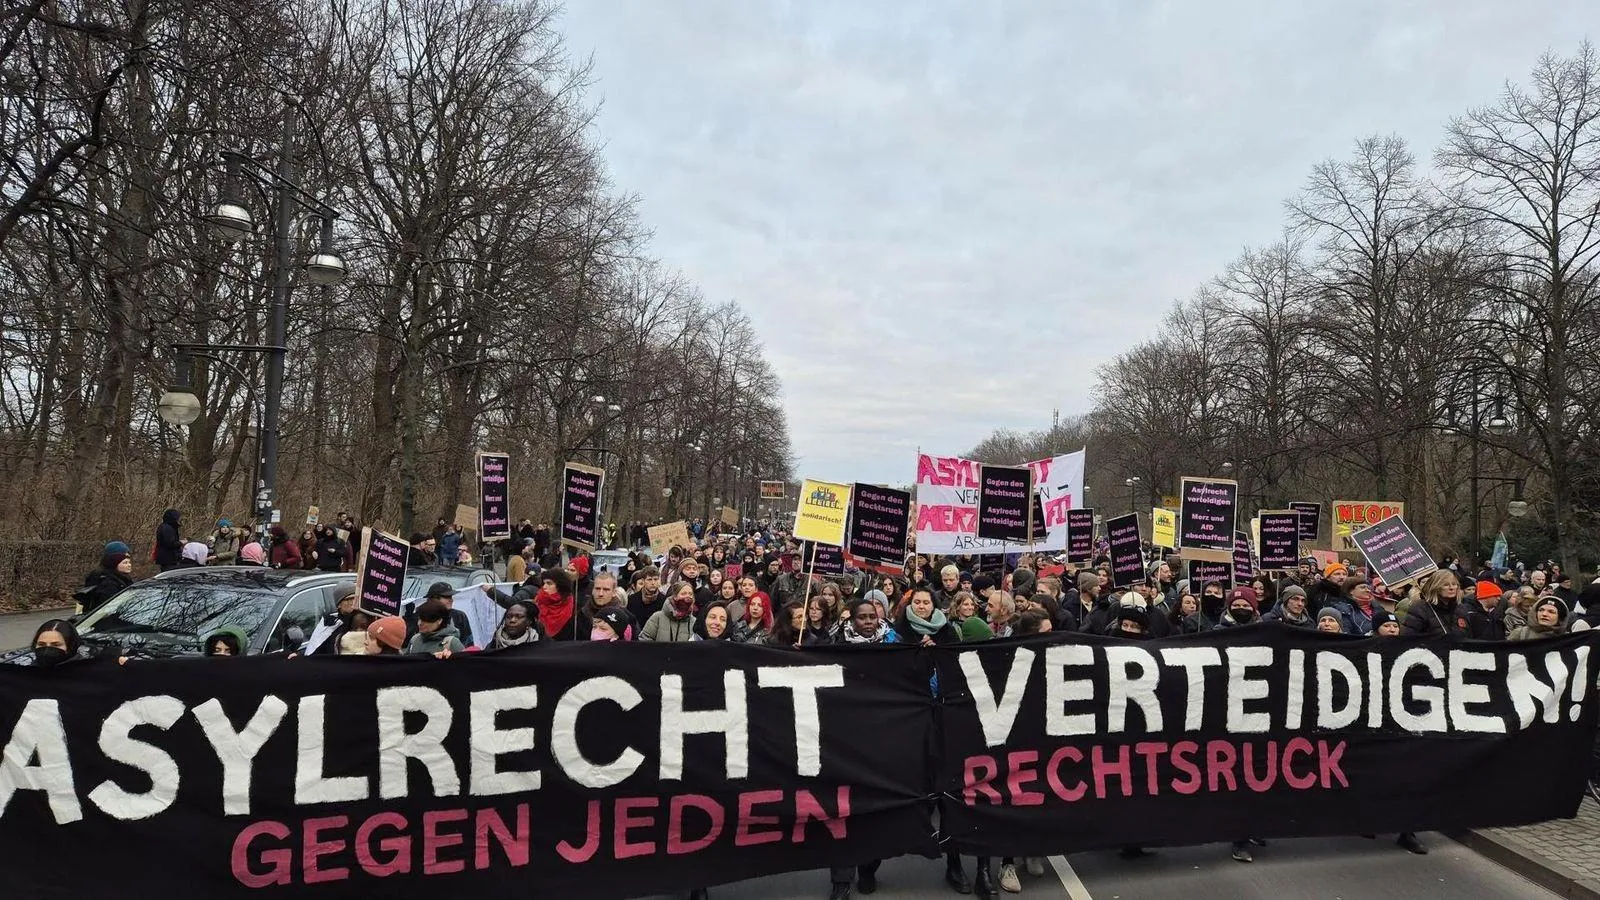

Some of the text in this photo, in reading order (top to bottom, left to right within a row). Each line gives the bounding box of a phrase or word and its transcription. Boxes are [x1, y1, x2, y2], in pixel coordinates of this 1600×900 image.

[917, 454, 1053, 488] ASYLT
[987, 478, 1009, 487] Gegen
[861, 490, 903, 504] Gegen den
[985, 488, 1025, 498] Rechtsruck
[1191, 487, 1228, 496] Asylrecht
[858, 500, 903, 516] Rechtsruck
[1188, 496, 1231, 506] verteidigen
[987, 507, 1021, 516] Asylrecht
[860, 519, 899, 533] Solidarität
[982, 517, 1025, 527] verteidigen!
[875, 534, 894, 543] allen
[1185, 533, 1229, 542] abschaffen!
[1364, 532, 1386, 545] Gegen
[1386, 526, 1400, 535] den
[1366, 532, 1406, 552] Rechtsruck
[374, 539, 402, 556] Asylrecht
[370, 550, 402, 568] verteidigen
[1380, 546, 1414, 564] Asylrecht
[370, 569, 384, 580] Merz
[377, 584, 388, 592] AfD
[0, 644, 1591, 824] ASYLRECHT VERTEIDIGEN!
[231, 736, 1350, 888] GEGEN JEDEN RECHTSRUCK
